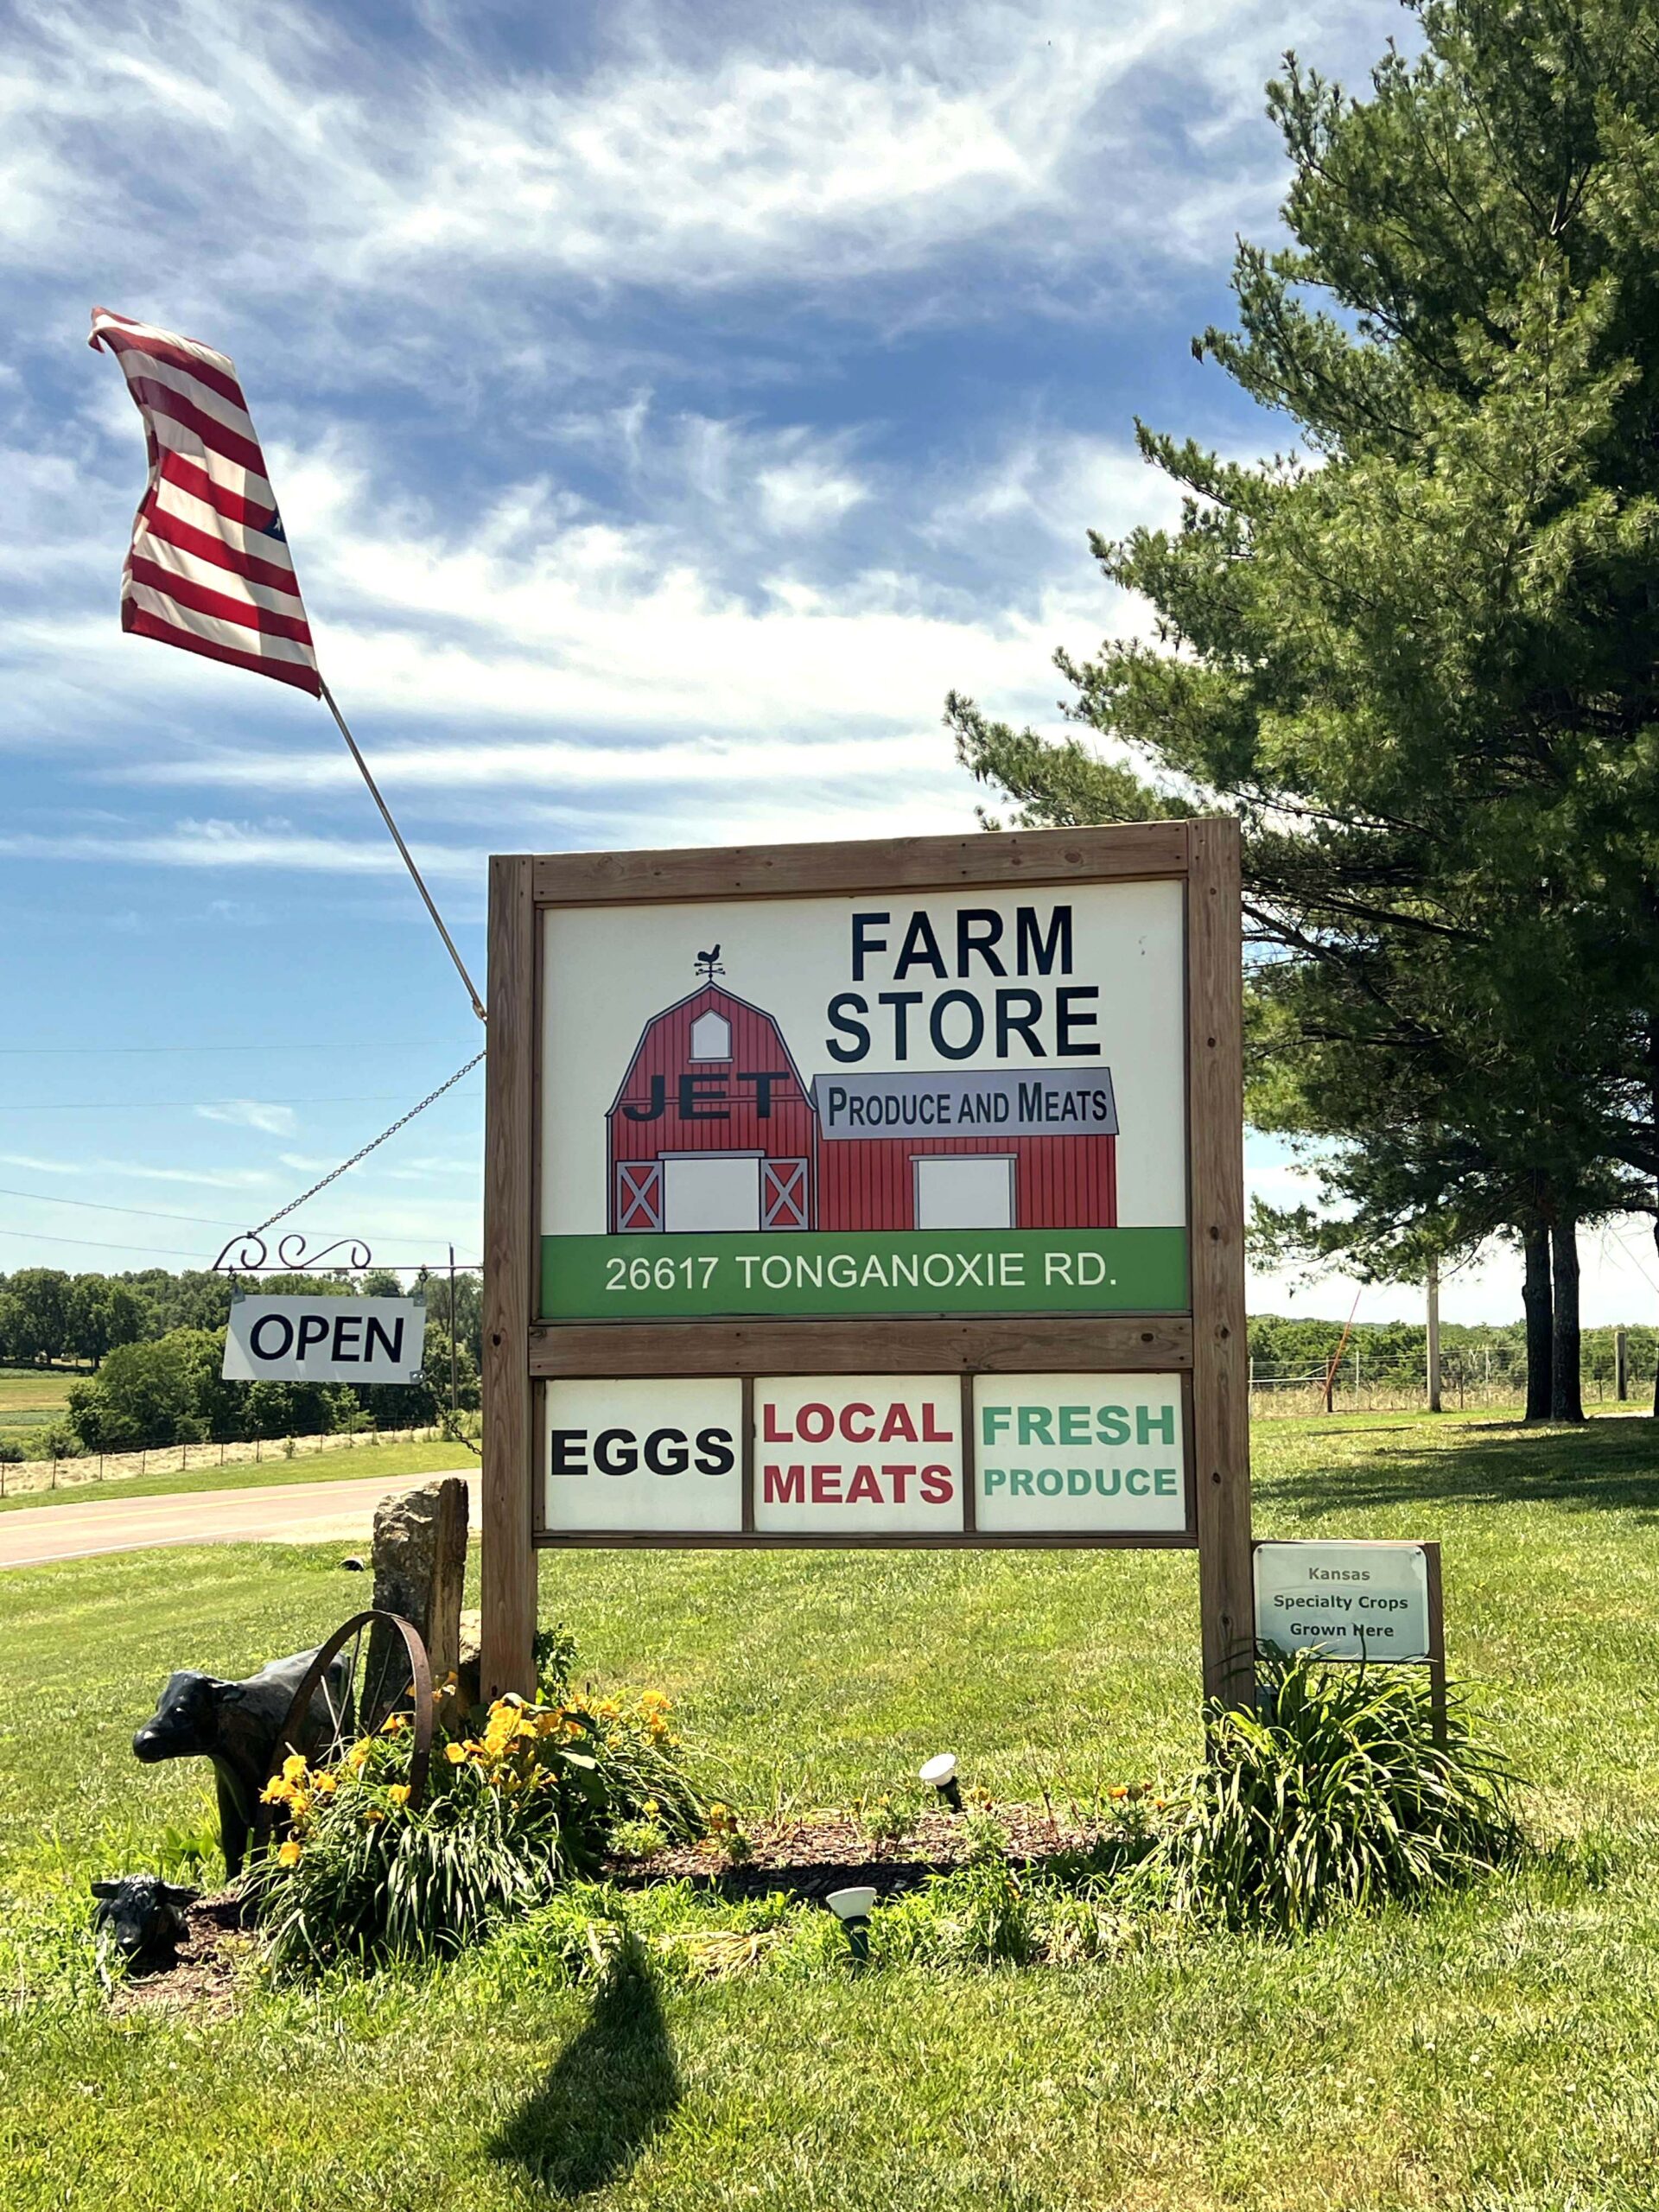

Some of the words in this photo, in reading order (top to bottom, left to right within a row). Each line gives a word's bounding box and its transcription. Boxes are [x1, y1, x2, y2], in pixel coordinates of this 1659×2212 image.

[851, 906, 1073, 982] FARM
[825, 986, 1102, 1063] STORE
[622, 1071, 790, 1122] JET
[957, 1091, 1009, 1123] AND
[606, 1257, 719, 1290] 26617
[735, 1252, 1026, 1288] TONGANOXIE
[1044, 1252, 1117, 1286] RD.
[250, 1313, 404, 1363] OPEN
[763, 1403, 953, 1444] LOCAL
[982, 1405, 1174, 1446] FRESH
[551, 1428, 734, 1476] EGGS
[763, 1465, 953, 1504] MEATS
[984, 1469, 1178, 1496] PRODUCE
[1309, 1567, 1370, 1581] Kansas
[1274, 1595, 1352, 1611] Specialty
[1358, 1596, 1408, 1611] Crops
[1290, 1623, 1346, 1637] Grown
[1353, 1624, 1394, 1637] Here
